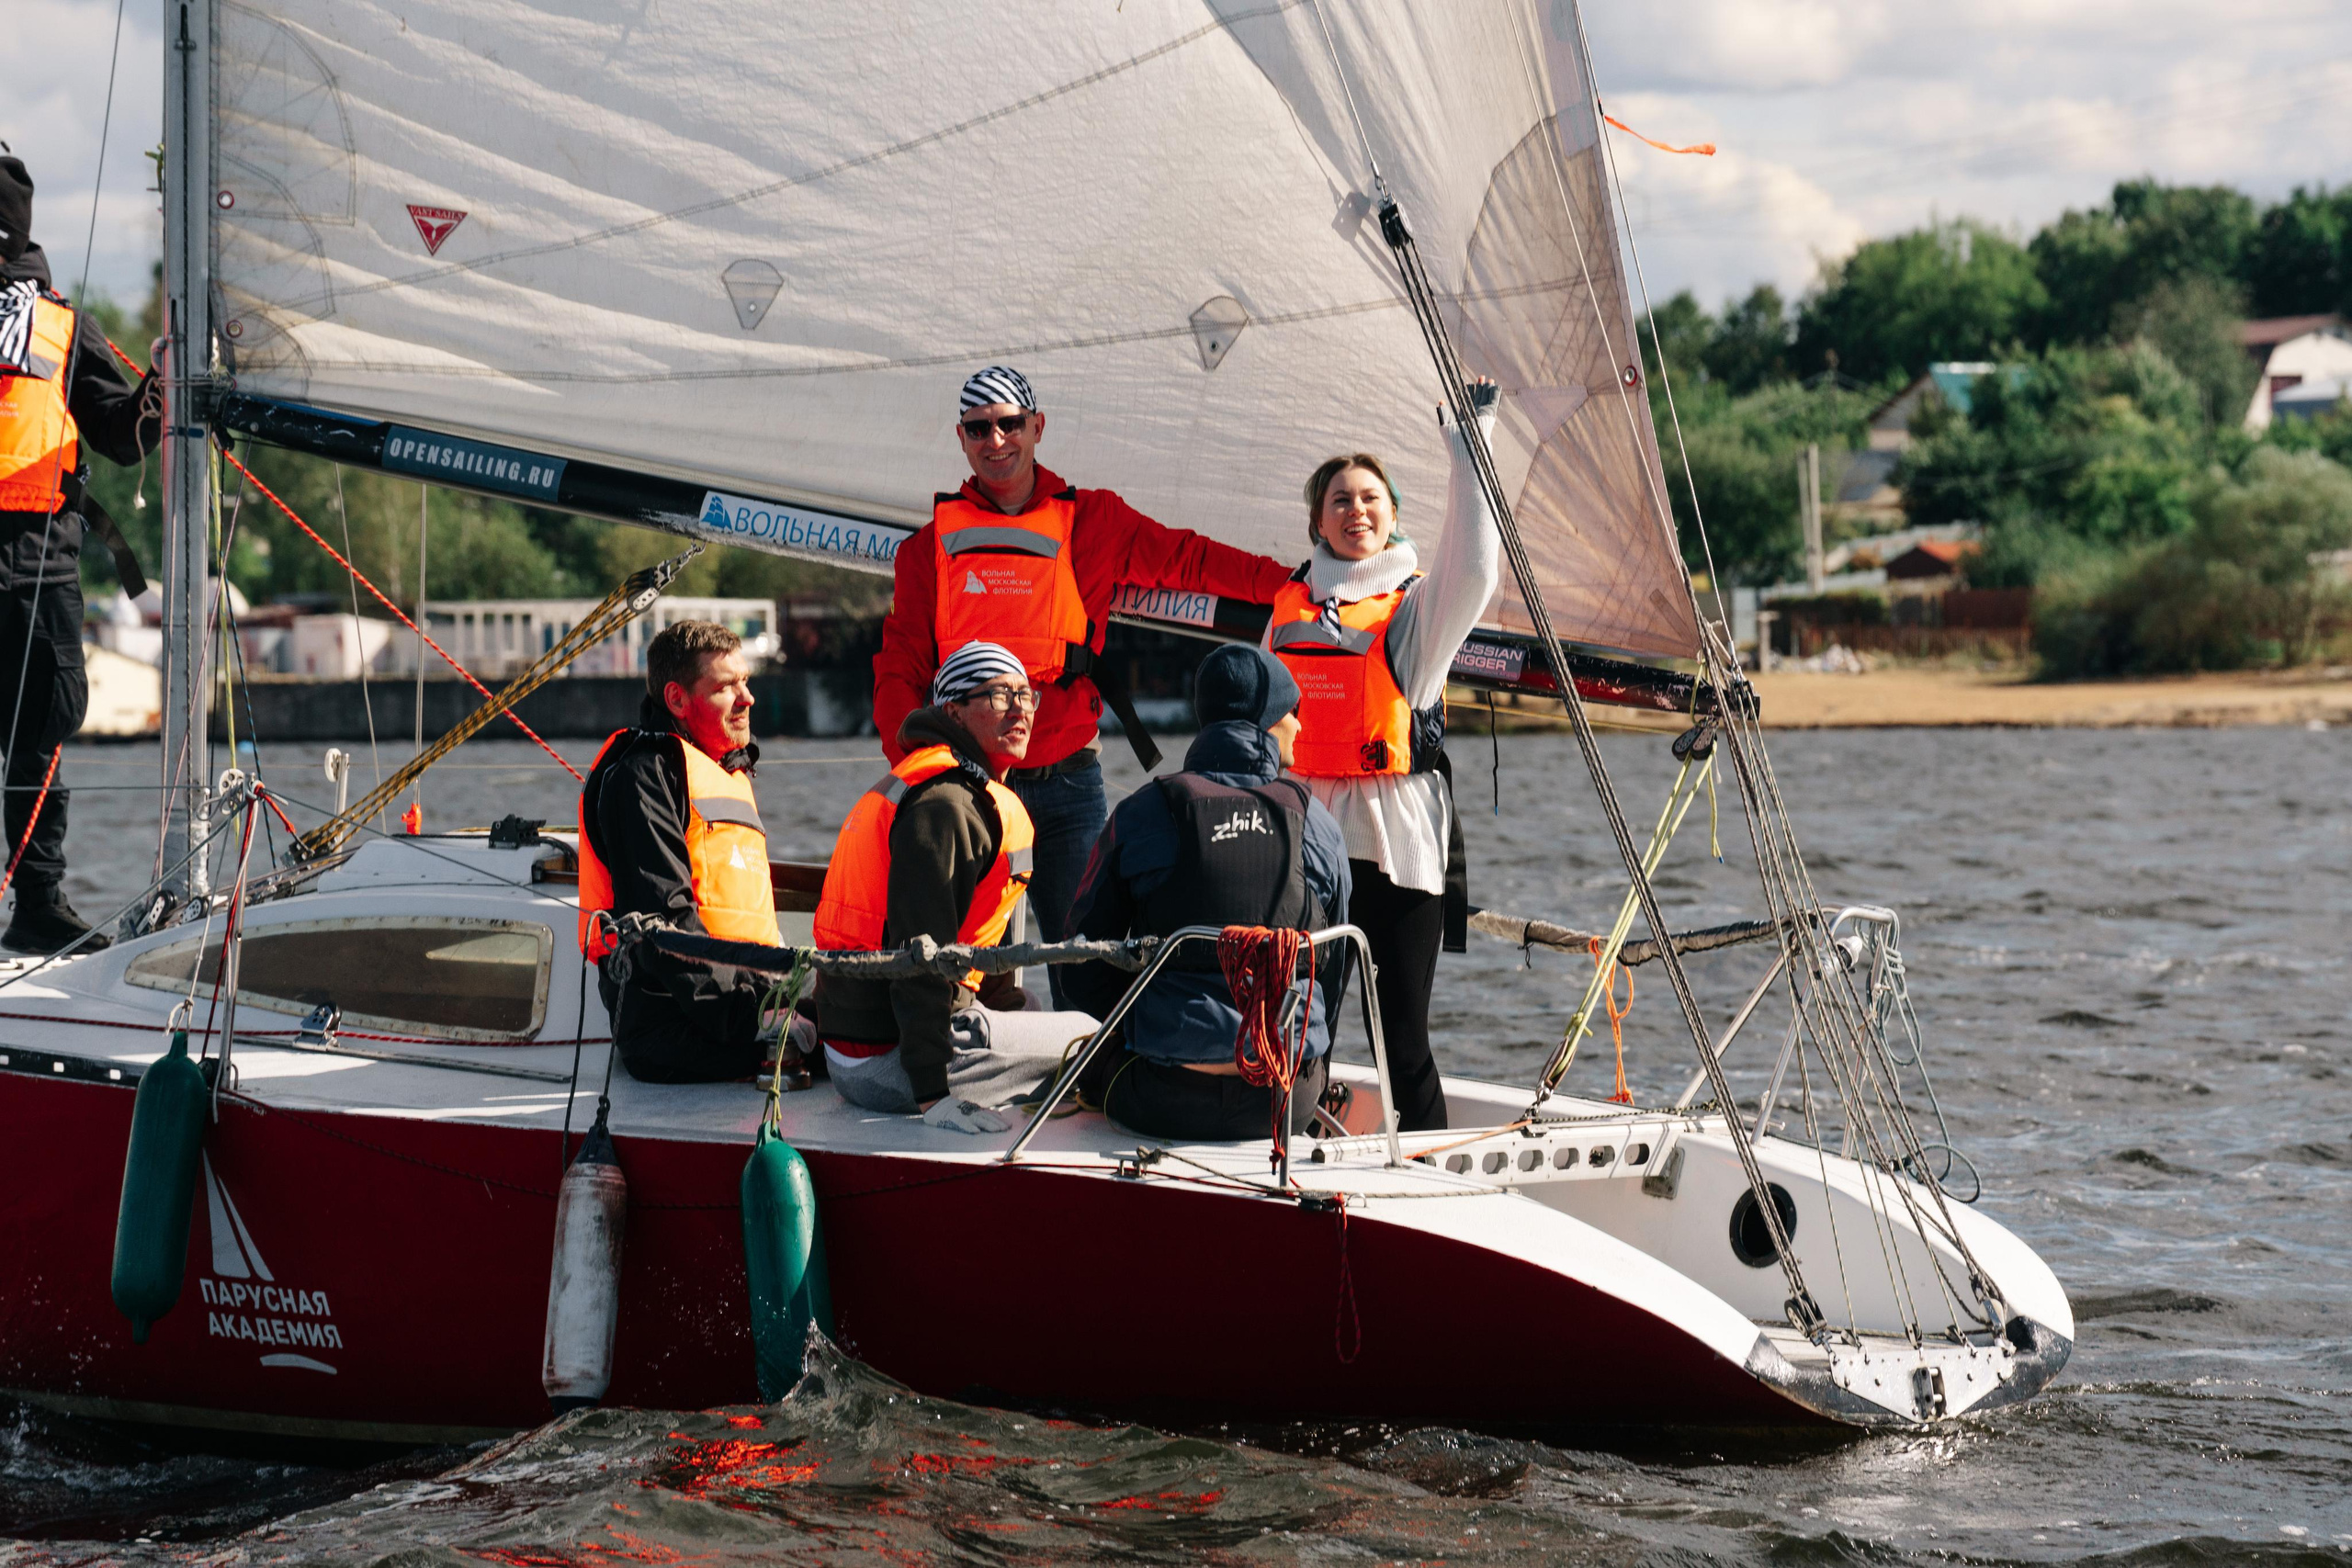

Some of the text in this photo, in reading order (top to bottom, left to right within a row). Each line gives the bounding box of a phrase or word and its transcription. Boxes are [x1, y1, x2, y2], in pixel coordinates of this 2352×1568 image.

[410, 206, 463, 220] VAST SAILS
[390, 437, 555, 488] OPENSAILING.RU
[735, 507, 861, 555] ВОЛЬНАЯ
[199, 1278, 331, 1316] ПАРУСНАЯ
[209, 1312, 343, 1349] АКАДЕМИЯ
